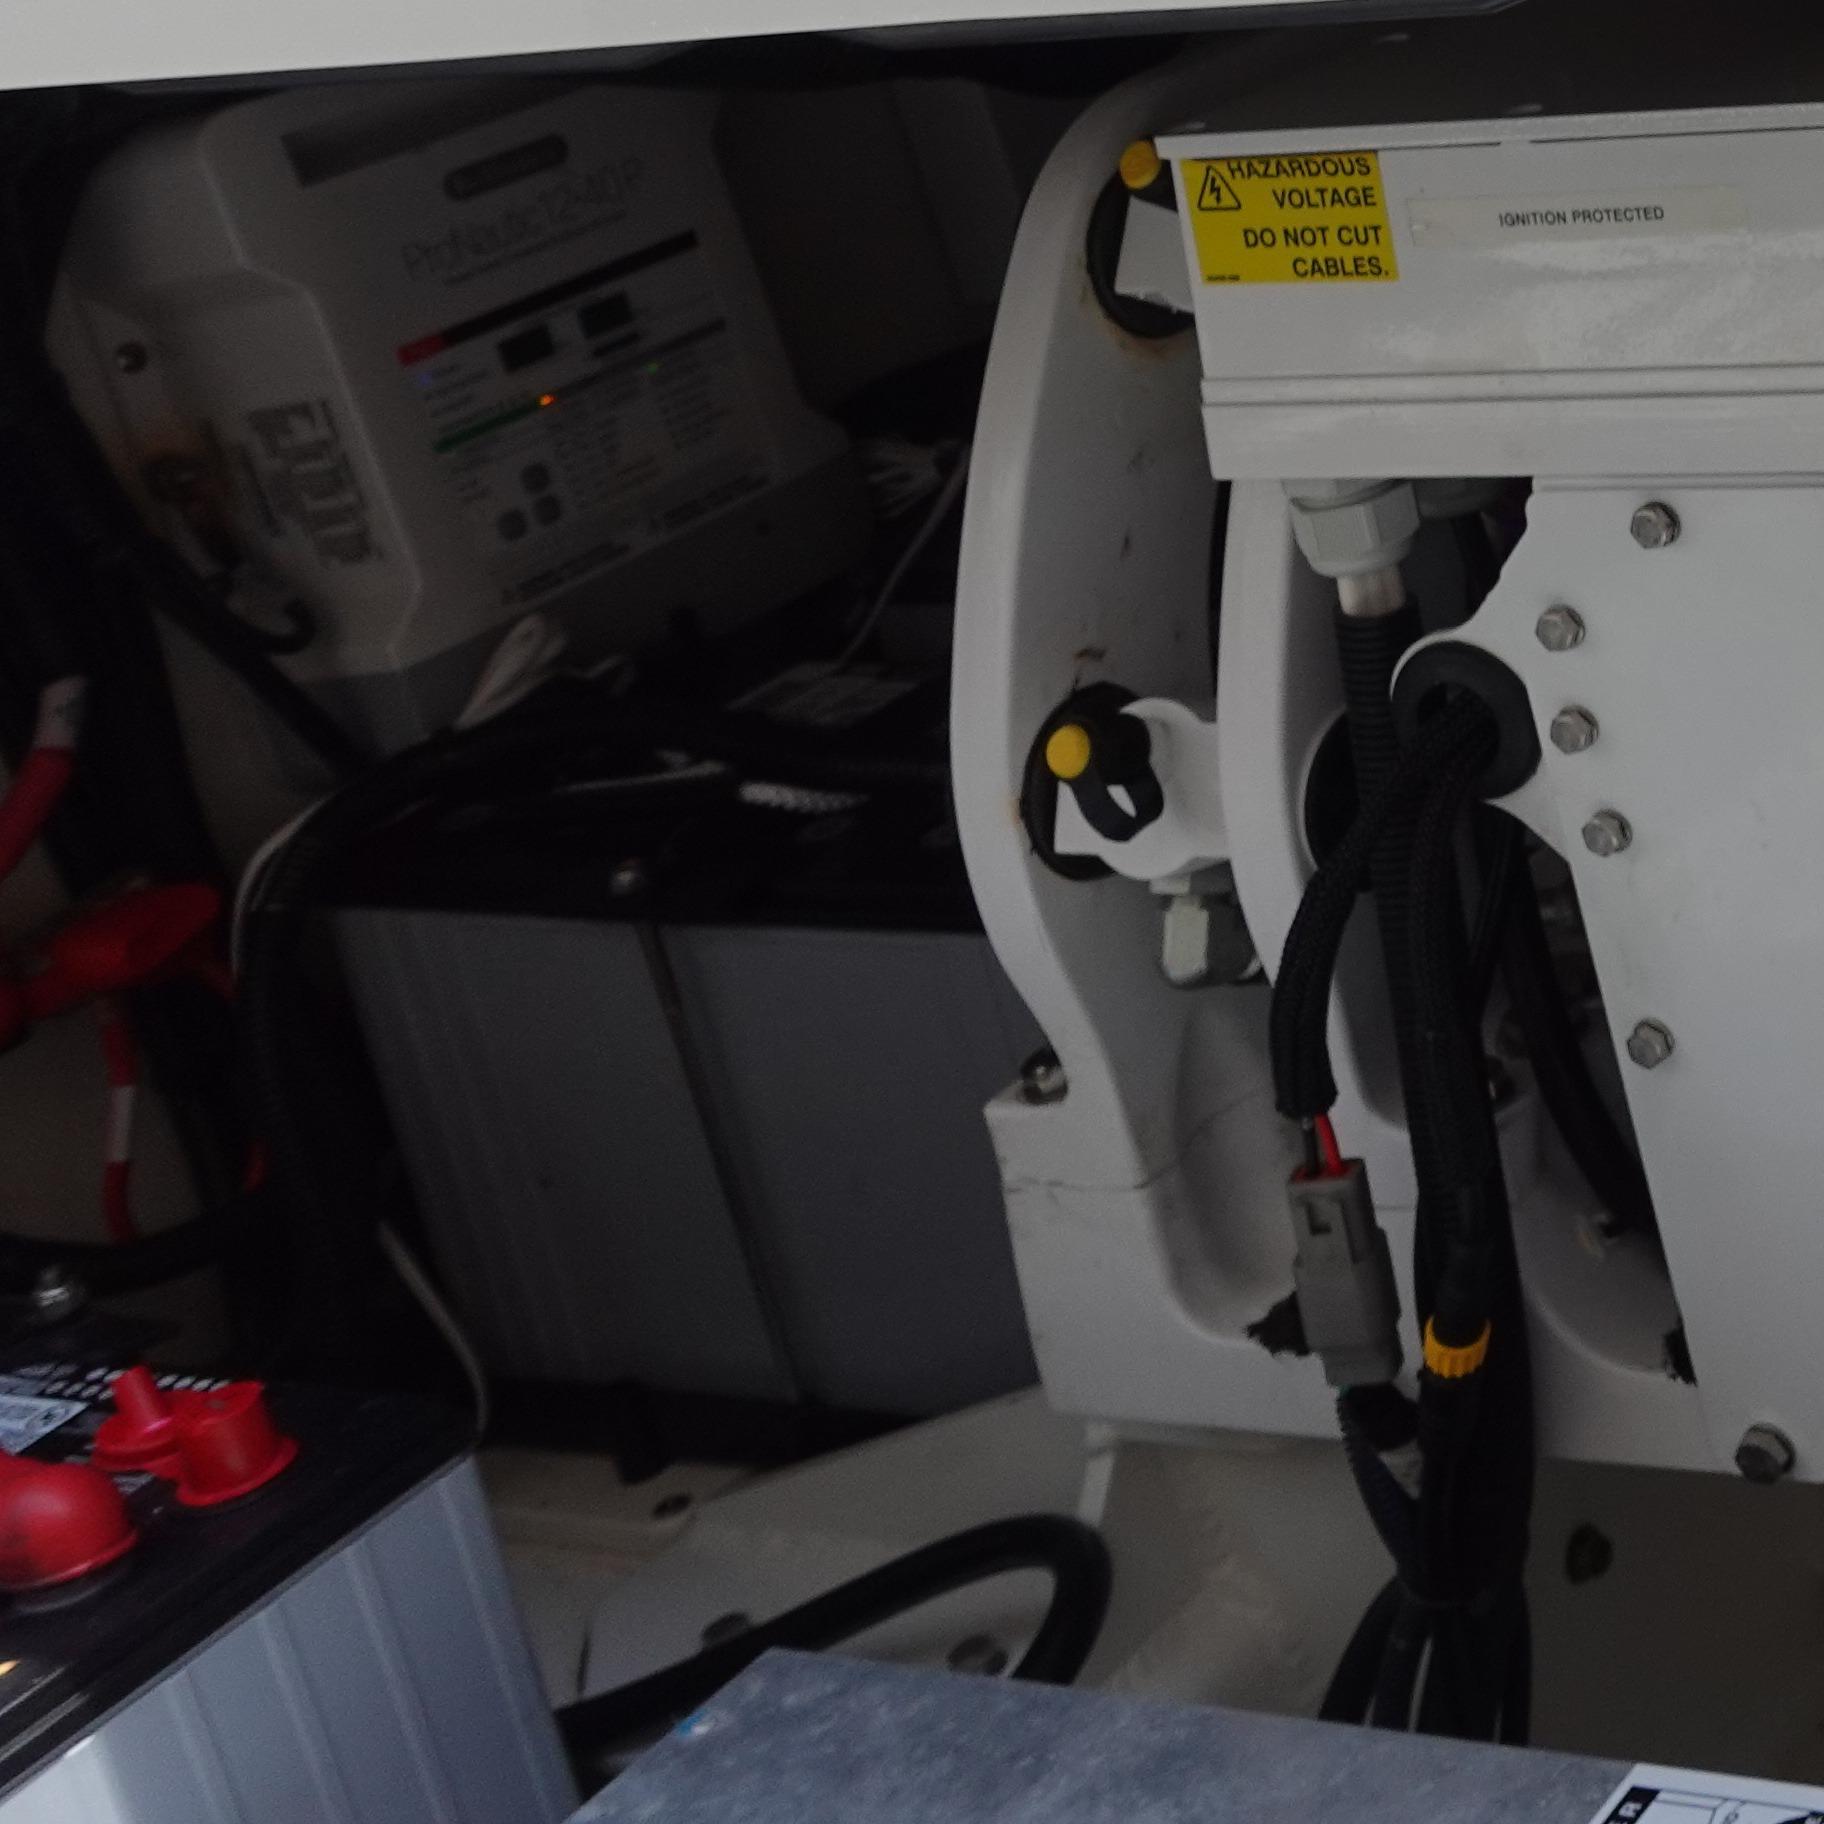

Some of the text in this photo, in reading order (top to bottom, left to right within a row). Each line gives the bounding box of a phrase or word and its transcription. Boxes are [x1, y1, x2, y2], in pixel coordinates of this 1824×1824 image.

[1228, 156, 1372, 181] HAZARDOUS
[1273, 186, 1377, 209] VOLTAGE
[1499, 206, 1665, 227] IGNITION PROTECTED
[1243, 224, 1383, 248] DO NOT CUT
[1292, 256, 1390, 278] CABLES.
